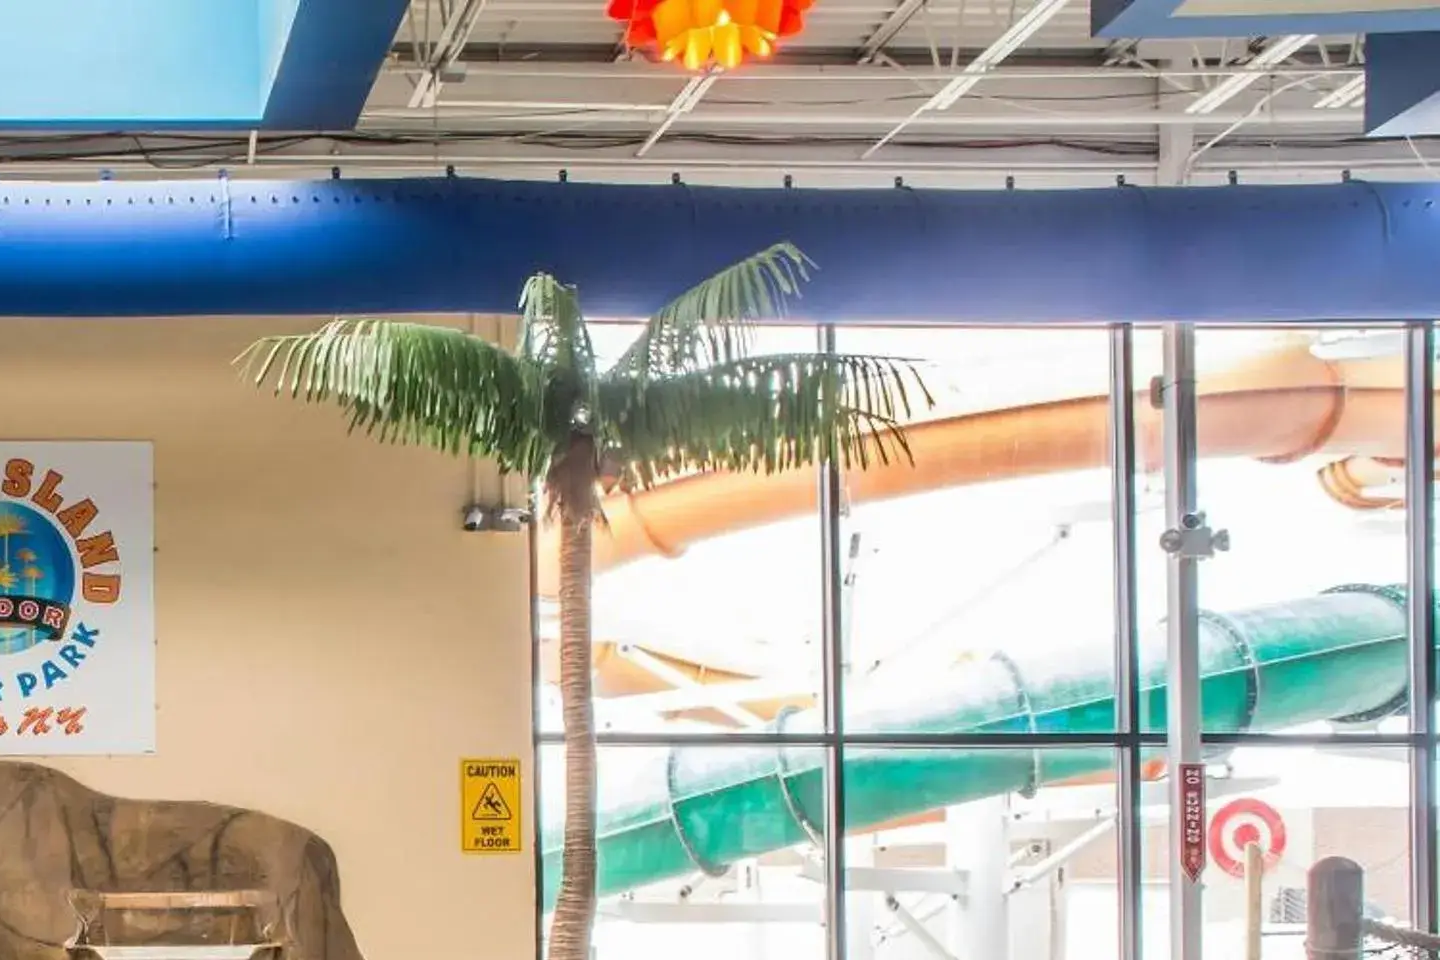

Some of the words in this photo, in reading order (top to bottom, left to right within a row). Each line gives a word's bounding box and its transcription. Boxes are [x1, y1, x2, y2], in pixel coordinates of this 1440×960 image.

[16, 621, 100, 698] PARK
[467, 765, 516, 777] CAUTION
[481, 826, 505, 836] WET
[474, 837, 511, 847] FLOOR
